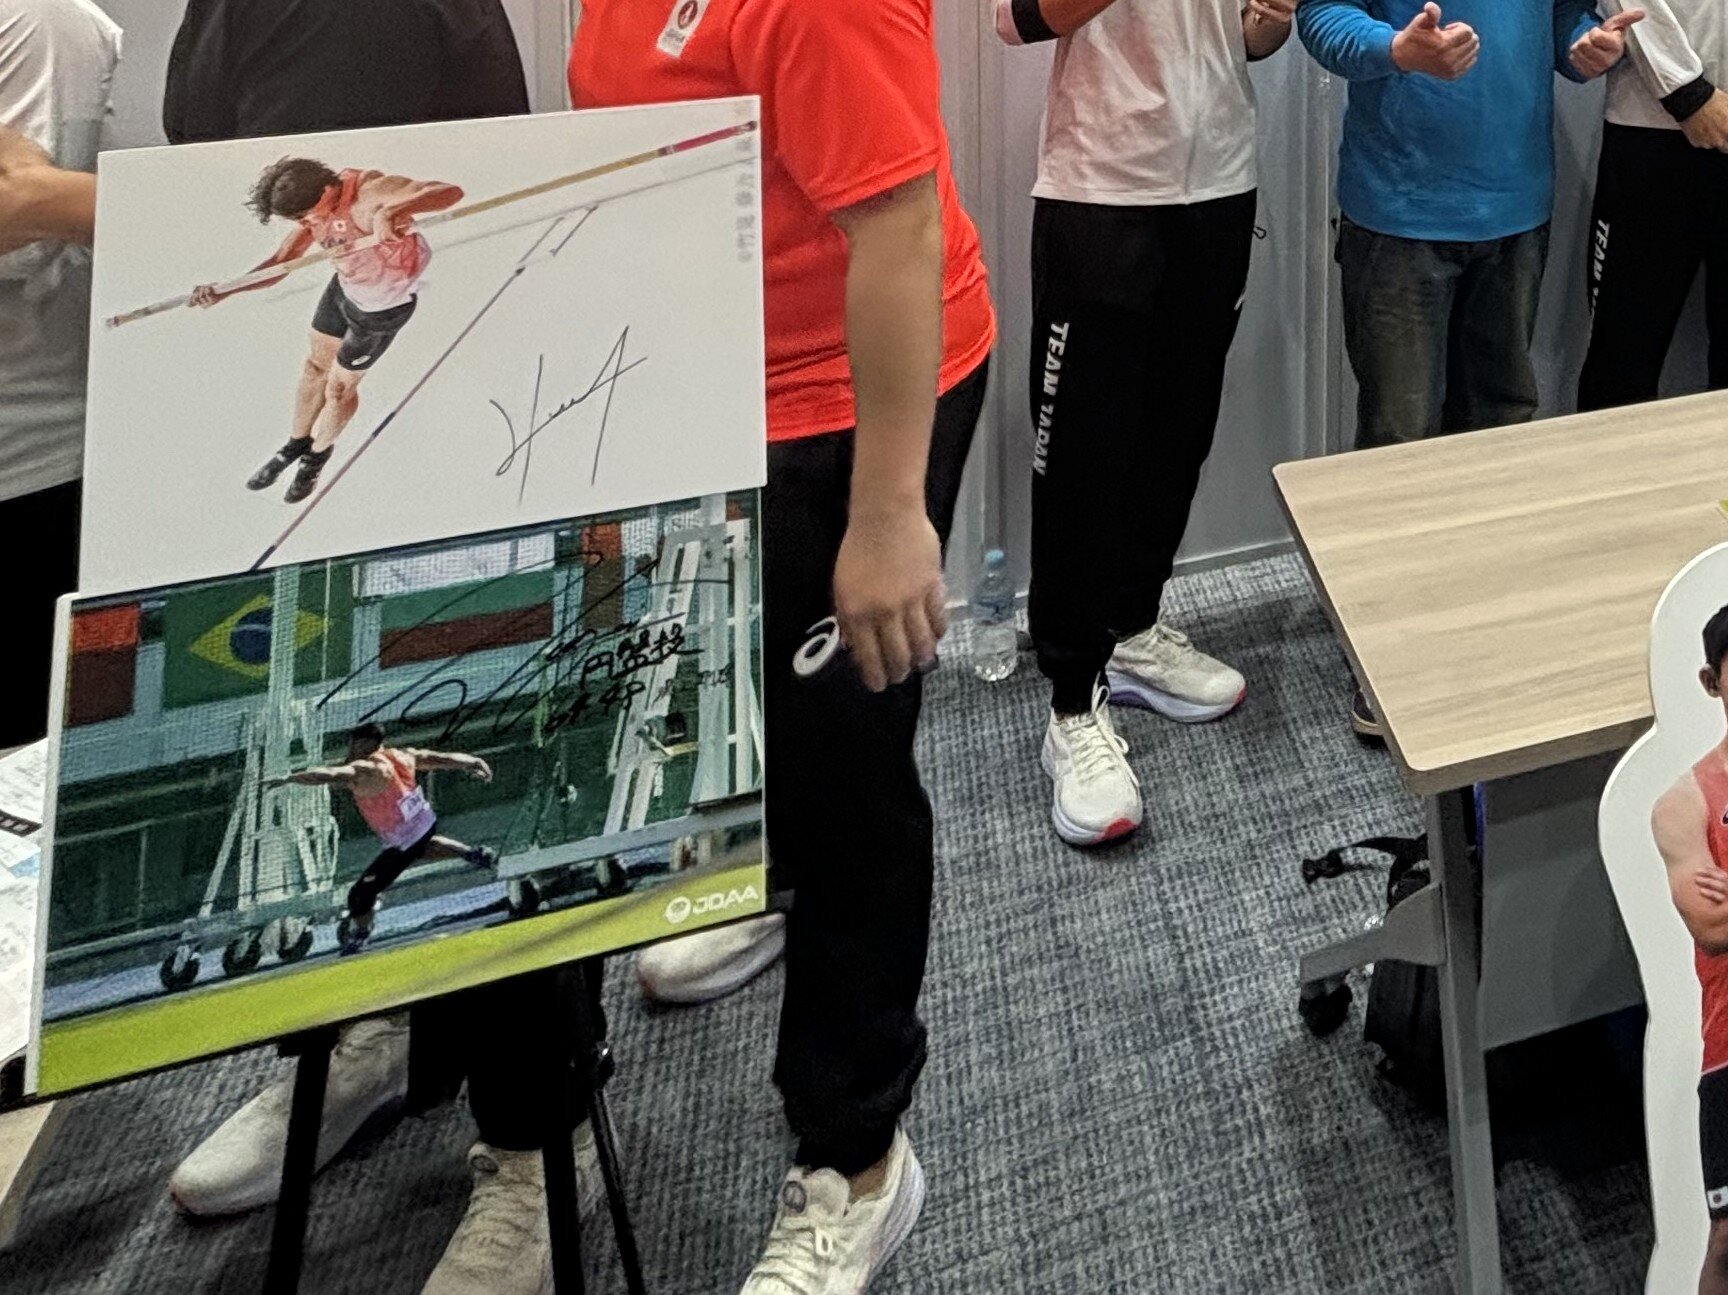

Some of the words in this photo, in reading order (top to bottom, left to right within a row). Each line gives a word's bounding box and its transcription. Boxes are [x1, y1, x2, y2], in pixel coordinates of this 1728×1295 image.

[1592, 219, 1610, 281] TEAM
[1042, 321, 1071, 397] TEAM
[1032, 404, 1055, 477] JAPAN
[692, 884, 759, 916] JDAA
